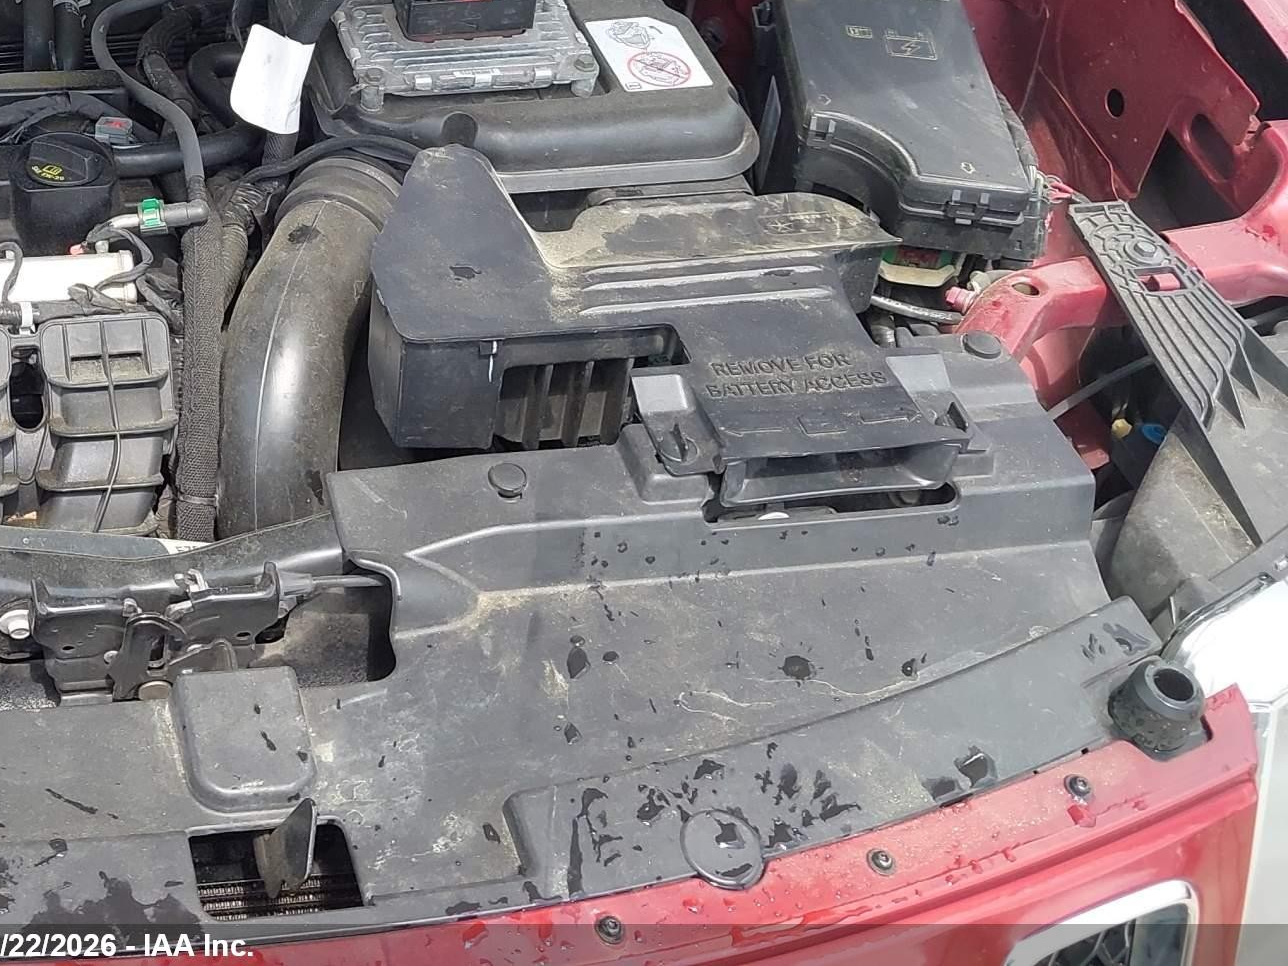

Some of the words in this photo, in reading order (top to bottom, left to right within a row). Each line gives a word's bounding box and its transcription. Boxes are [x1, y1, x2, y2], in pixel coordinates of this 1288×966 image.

[711, 357, 801, 376] REMOVE
[804, 352, 851, 369] FOR
[705, 378, 796, 398] BATTERY
[804, 371, 887, 393] ACCESS
